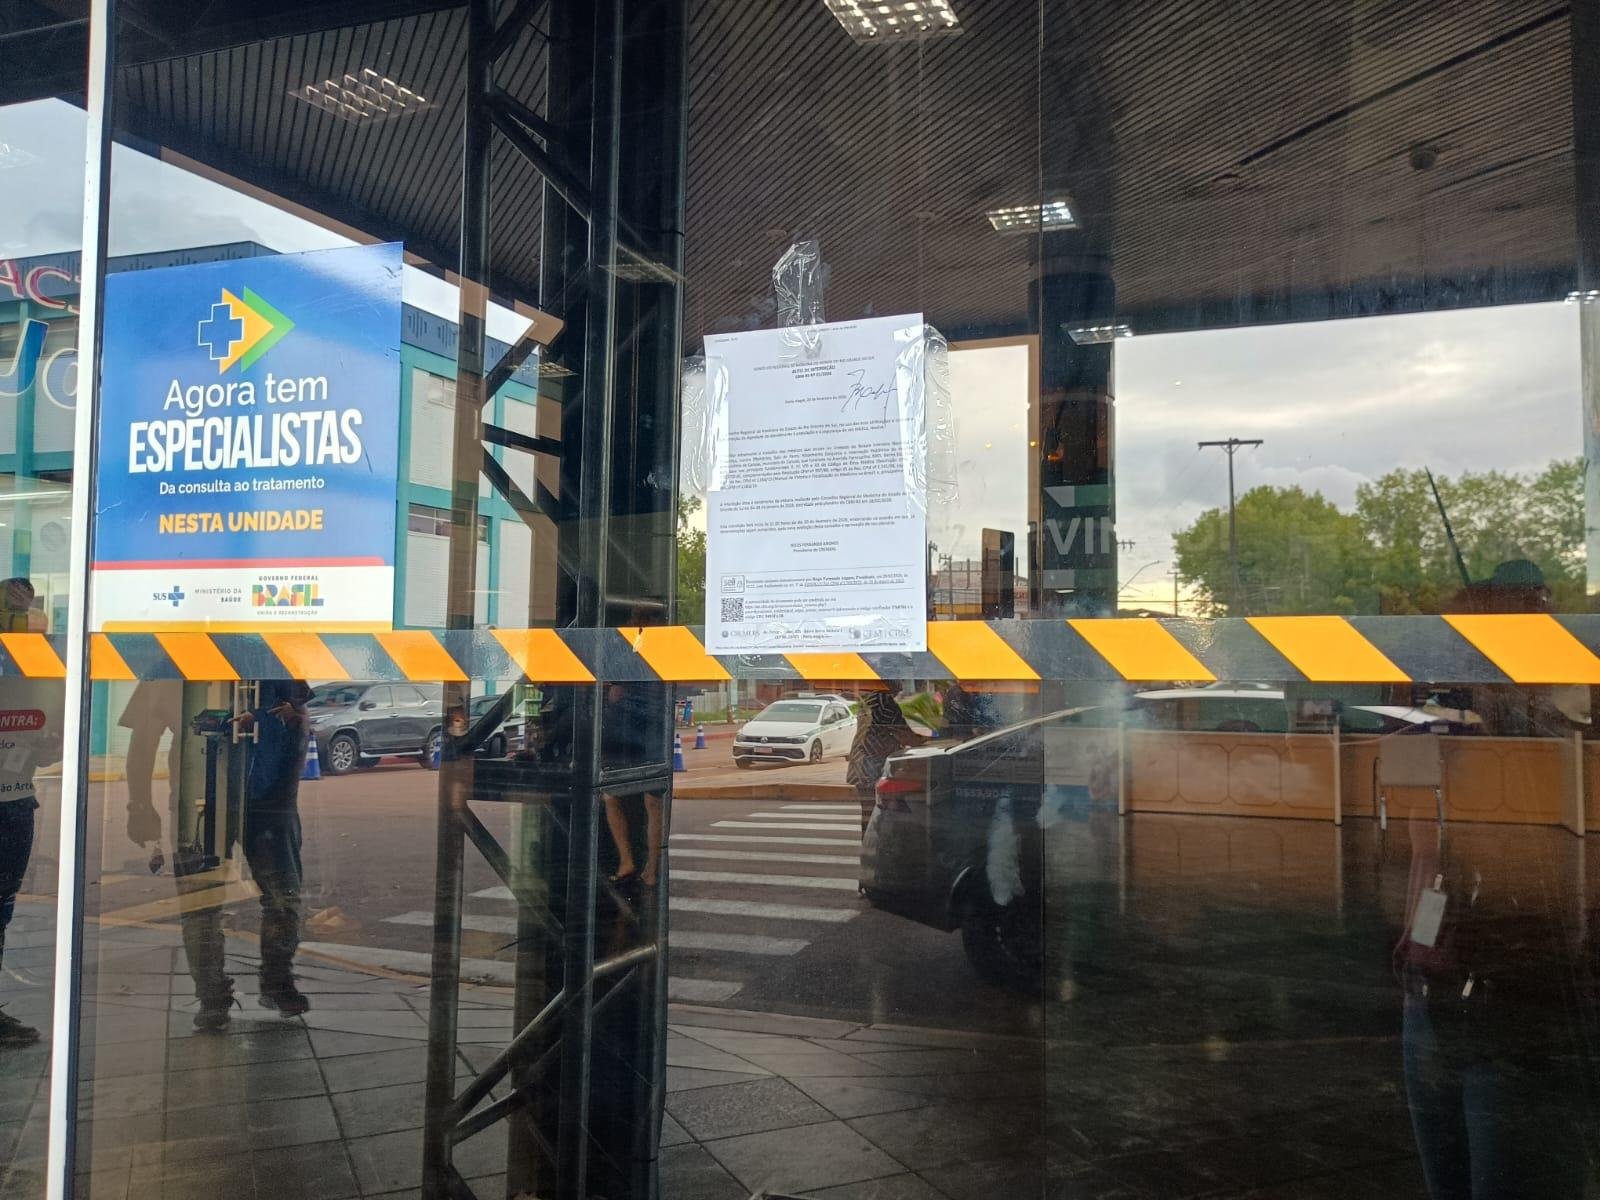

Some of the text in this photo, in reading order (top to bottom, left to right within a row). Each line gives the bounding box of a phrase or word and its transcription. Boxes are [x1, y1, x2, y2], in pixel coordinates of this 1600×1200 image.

[163, 373, 328, 417] Agora tem
[128, 408, 363, 474] ESPECIALISTAS
[159, 475, 325, 495] Da consulta ao tratamento
[159, 509, 324, 534] NESTA UNIDADE
[153, 592, 167, 601] SUS
[251, 583, 325, 607] BRASIL
[0, 714, 39, 728] NTRA:
